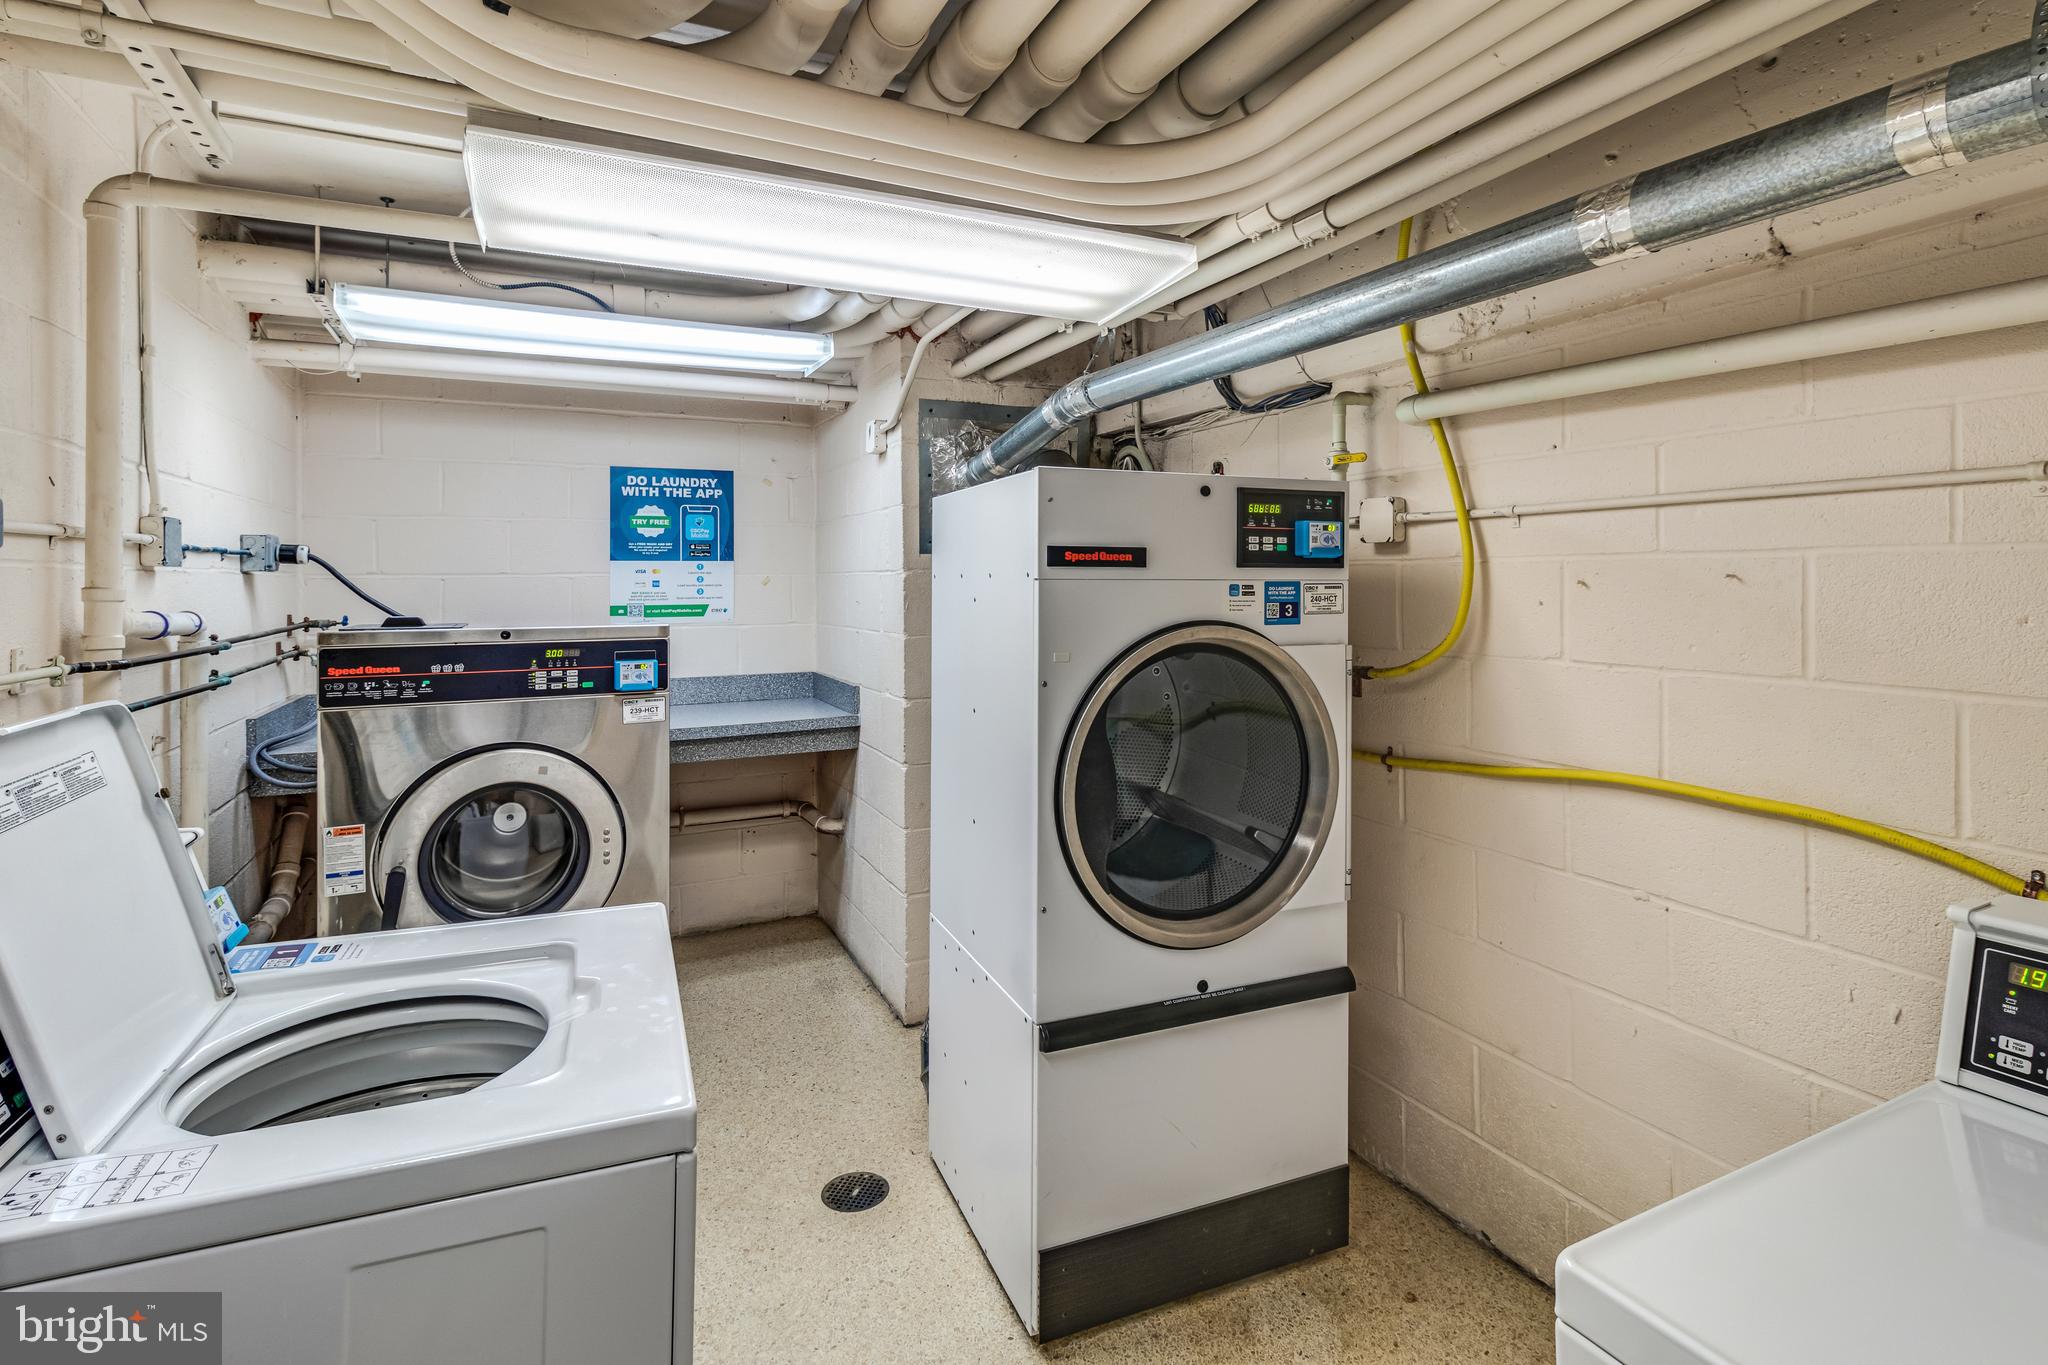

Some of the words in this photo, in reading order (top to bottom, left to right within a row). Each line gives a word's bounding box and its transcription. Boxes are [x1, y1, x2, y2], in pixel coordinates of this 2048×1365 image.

[627, 475, 647, 486] DO
[652, 476, 718, 488] LAUNDRY
[621, 486, 659, 496] WITH
[664, 487, 692, 498] THE
[696, 489, 723, 499] APP
[1064, 552, 1098, 562] Speed
[1100, 552, 1133, 561] Queen
[1285, 604, 1293, 616] 3
[546, 649, 563, 657] 3.00
[328, 666, 364, 676] Speed
